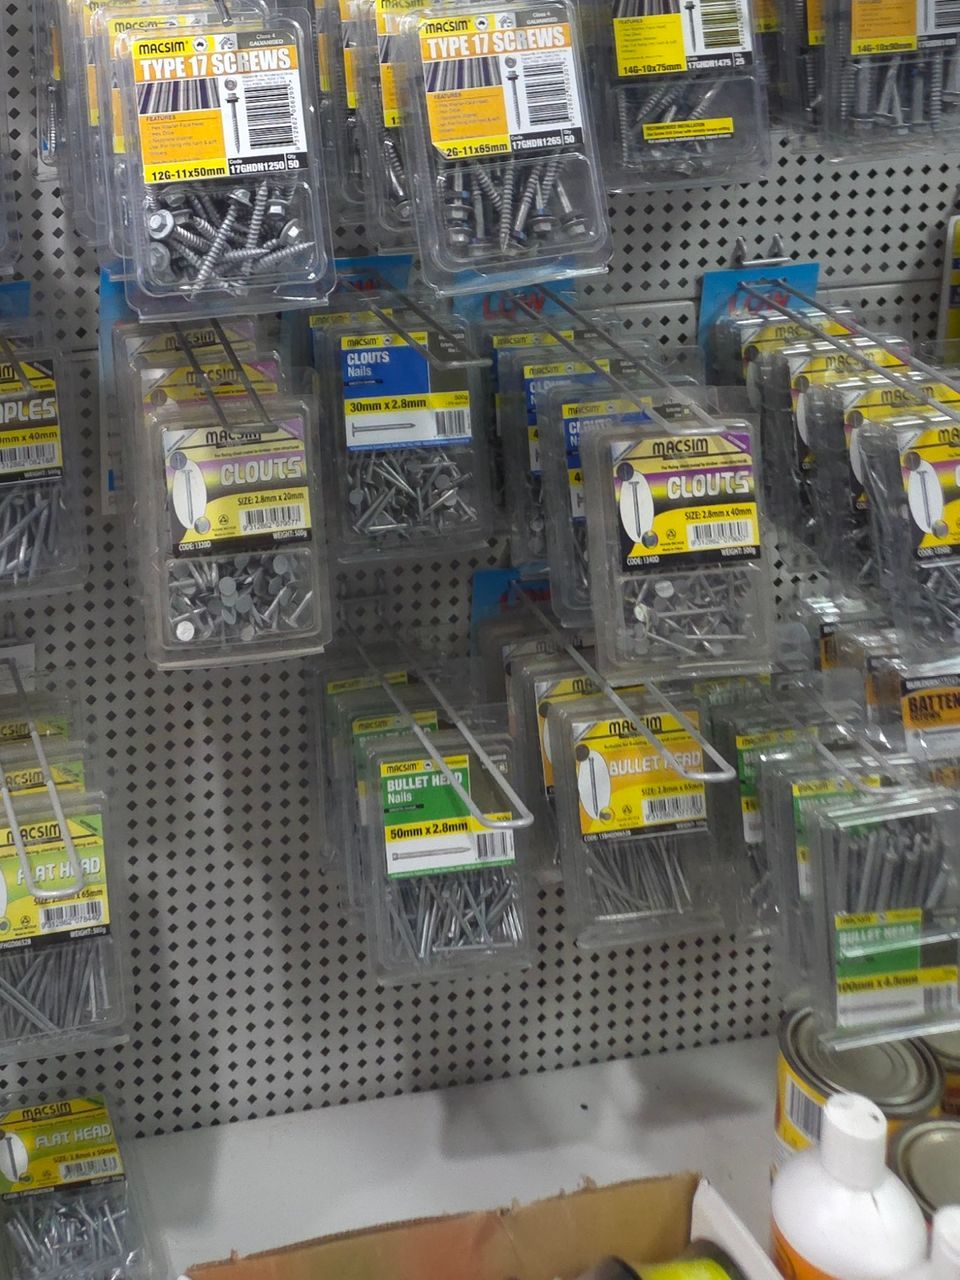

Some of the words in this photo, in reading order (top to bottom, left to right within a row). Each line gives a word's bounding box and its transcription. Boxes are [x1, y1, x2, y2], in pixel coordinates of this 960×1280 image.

[425, 22, 468, 34] MACSIM
[139, 42, 186, 55] MACSIM
[427, 36, 469, 58] TYPE
[471, 34, 489, 55] 17
[493, 27, 564, 51] SCREWS
[140, 57, 185, 80] TYPE
[186, 54, 207, 77] 17
[212, 49, 291, 74] SCREWS
[288, 160, 300, 168] 50
[151, 167, 225, 181] 12G-11x50mm
[347, 351, 389, 365] CLOUTS
[348, 367, 372, 377] Nails
[350, 402, 382, 412] 30mm
[392, 398, 426, 409] 2.8mm
[653, 438, 708, 455] MACSIM
[221, 457, 302, 486] CLOUTS
[667, 471, 749, 499] CLOUTS
[238, 498, 253, 506] SIZE:
[255, 495, 277, 504] 2.8mm
[283, 492, 304, 501] 20mm
[685, 511, 702, 520] SIZE:
[702, 509, 726, 519] 2.8mm
[731, 507, 752, 516] 40mm
[387, 764, 417, 773] MACSIM
[611, 758, 660, 776] BULLET
[387, 776, 428, 791] BULLET
[388, 792, 412, 803] Nails
[390, 828, 422, 839] 50mm
[433, 822, 468, 833] 2.8mm
[22, 1103, 71, 1119] MACSIM
[36, 1134, 70, 1149] FLAT
[74, 1124, 112, 1140] HEAD
